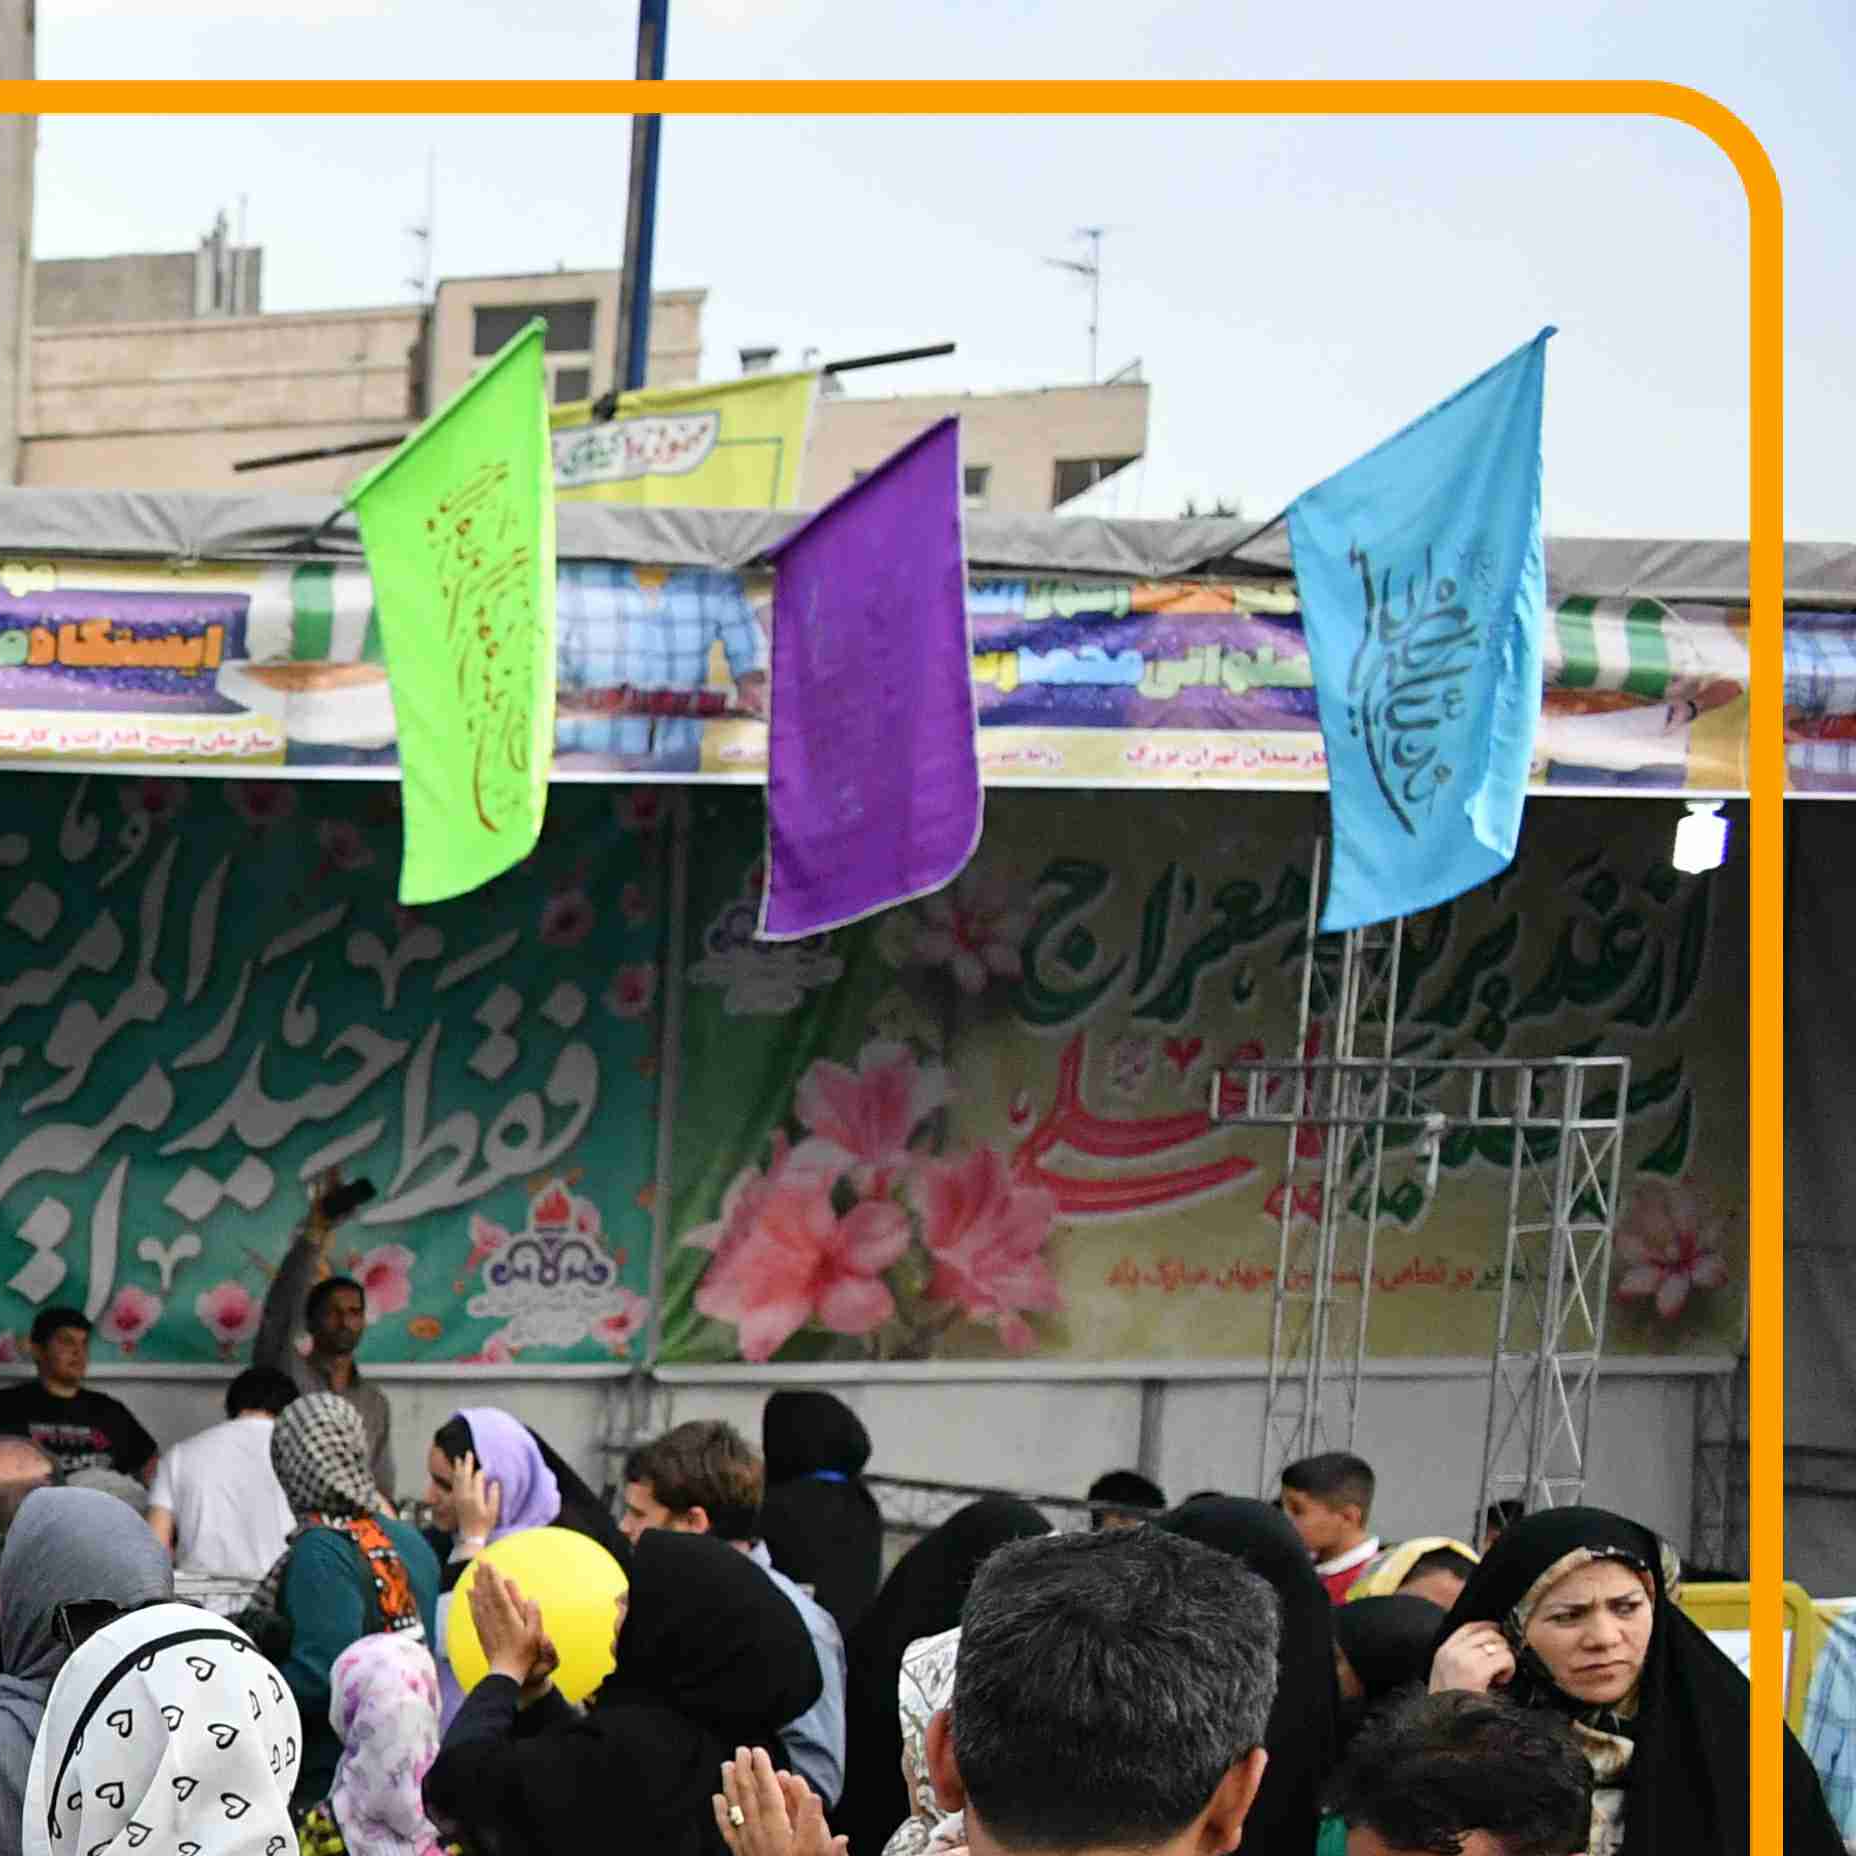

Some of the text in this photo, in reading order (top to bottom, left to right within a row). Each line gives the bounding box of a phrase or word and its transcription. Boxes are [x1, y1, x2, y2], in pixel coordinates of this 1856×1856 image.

[27, 617, 226, 677] ایستگاه
[1017, 646, 1145, 686] محمد
[360, 981, 600, 1225] فقط
